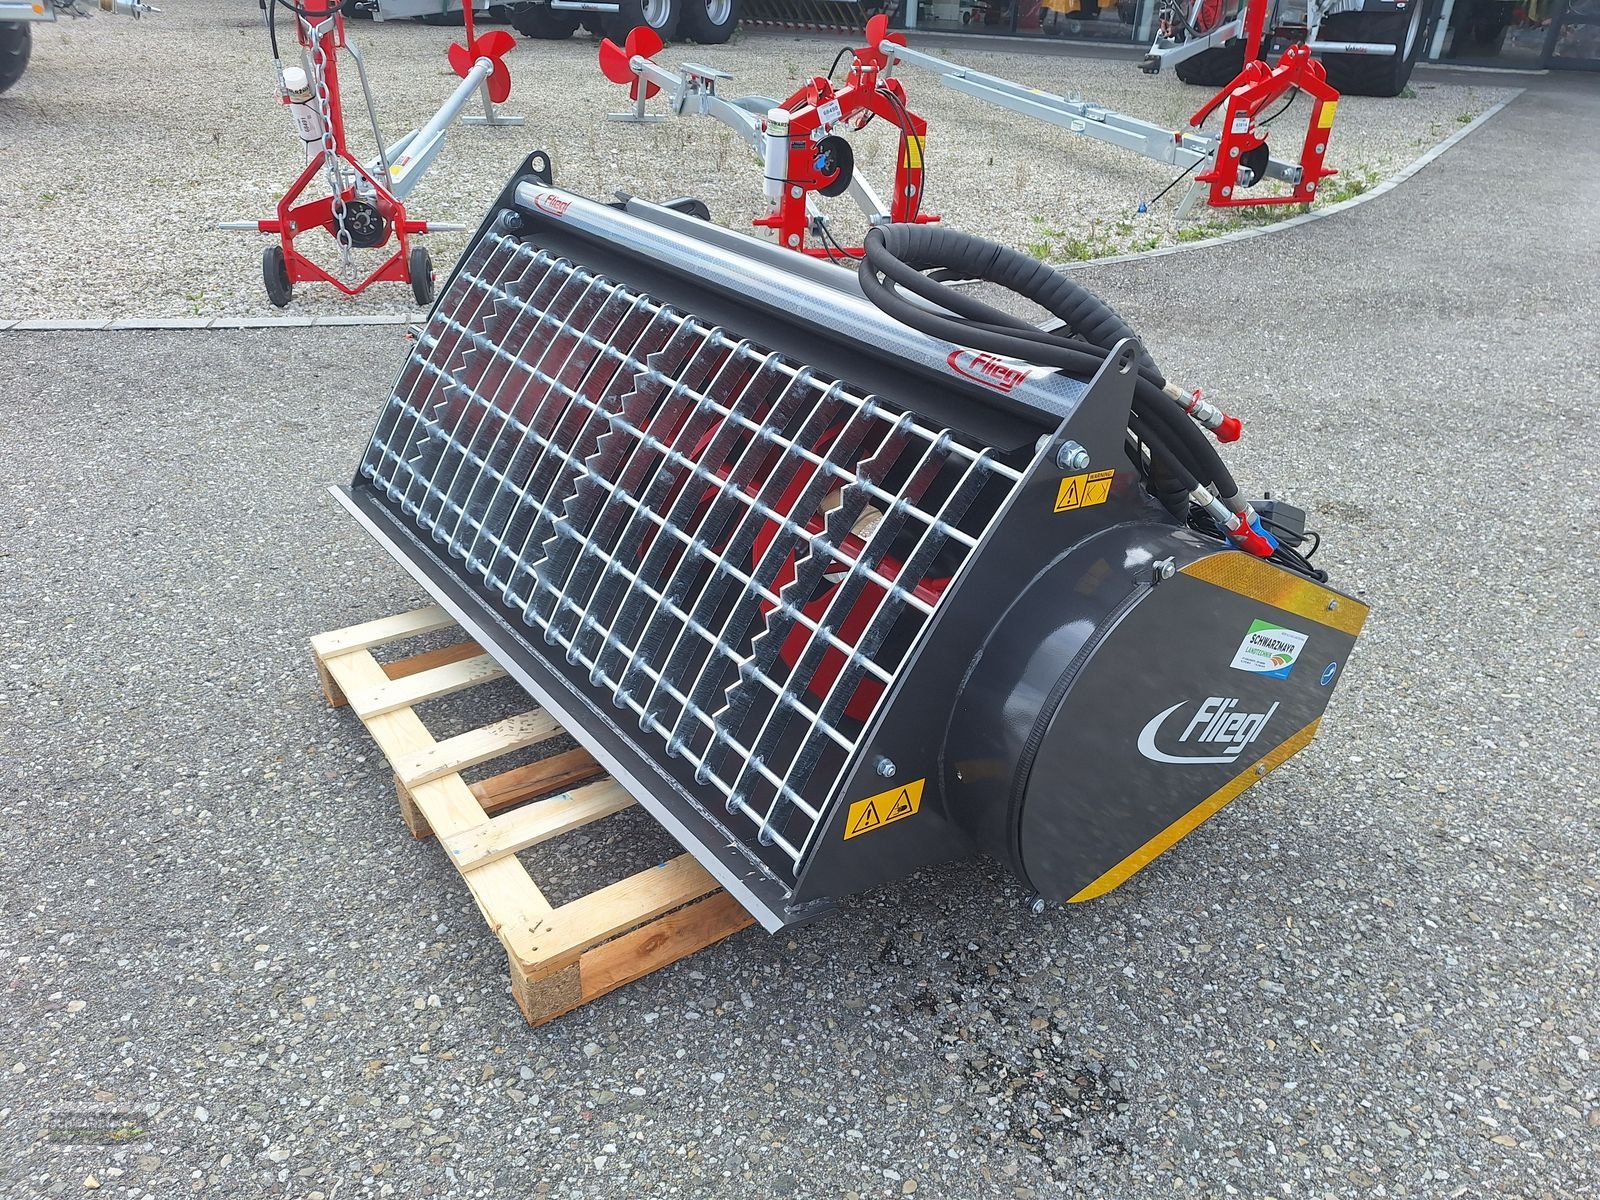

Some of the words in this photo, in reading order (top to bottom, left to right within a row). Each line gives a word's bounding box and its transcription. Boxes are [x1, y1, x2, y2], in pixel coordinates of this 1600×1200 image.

[544, 194, 573, 214] Fliegl
[970, 353, 1031, 388] Fliegl
[1250, 633, 1295, 654] SCHWARZMAYR
[1178, 696, 1280, 754] Fliegl
